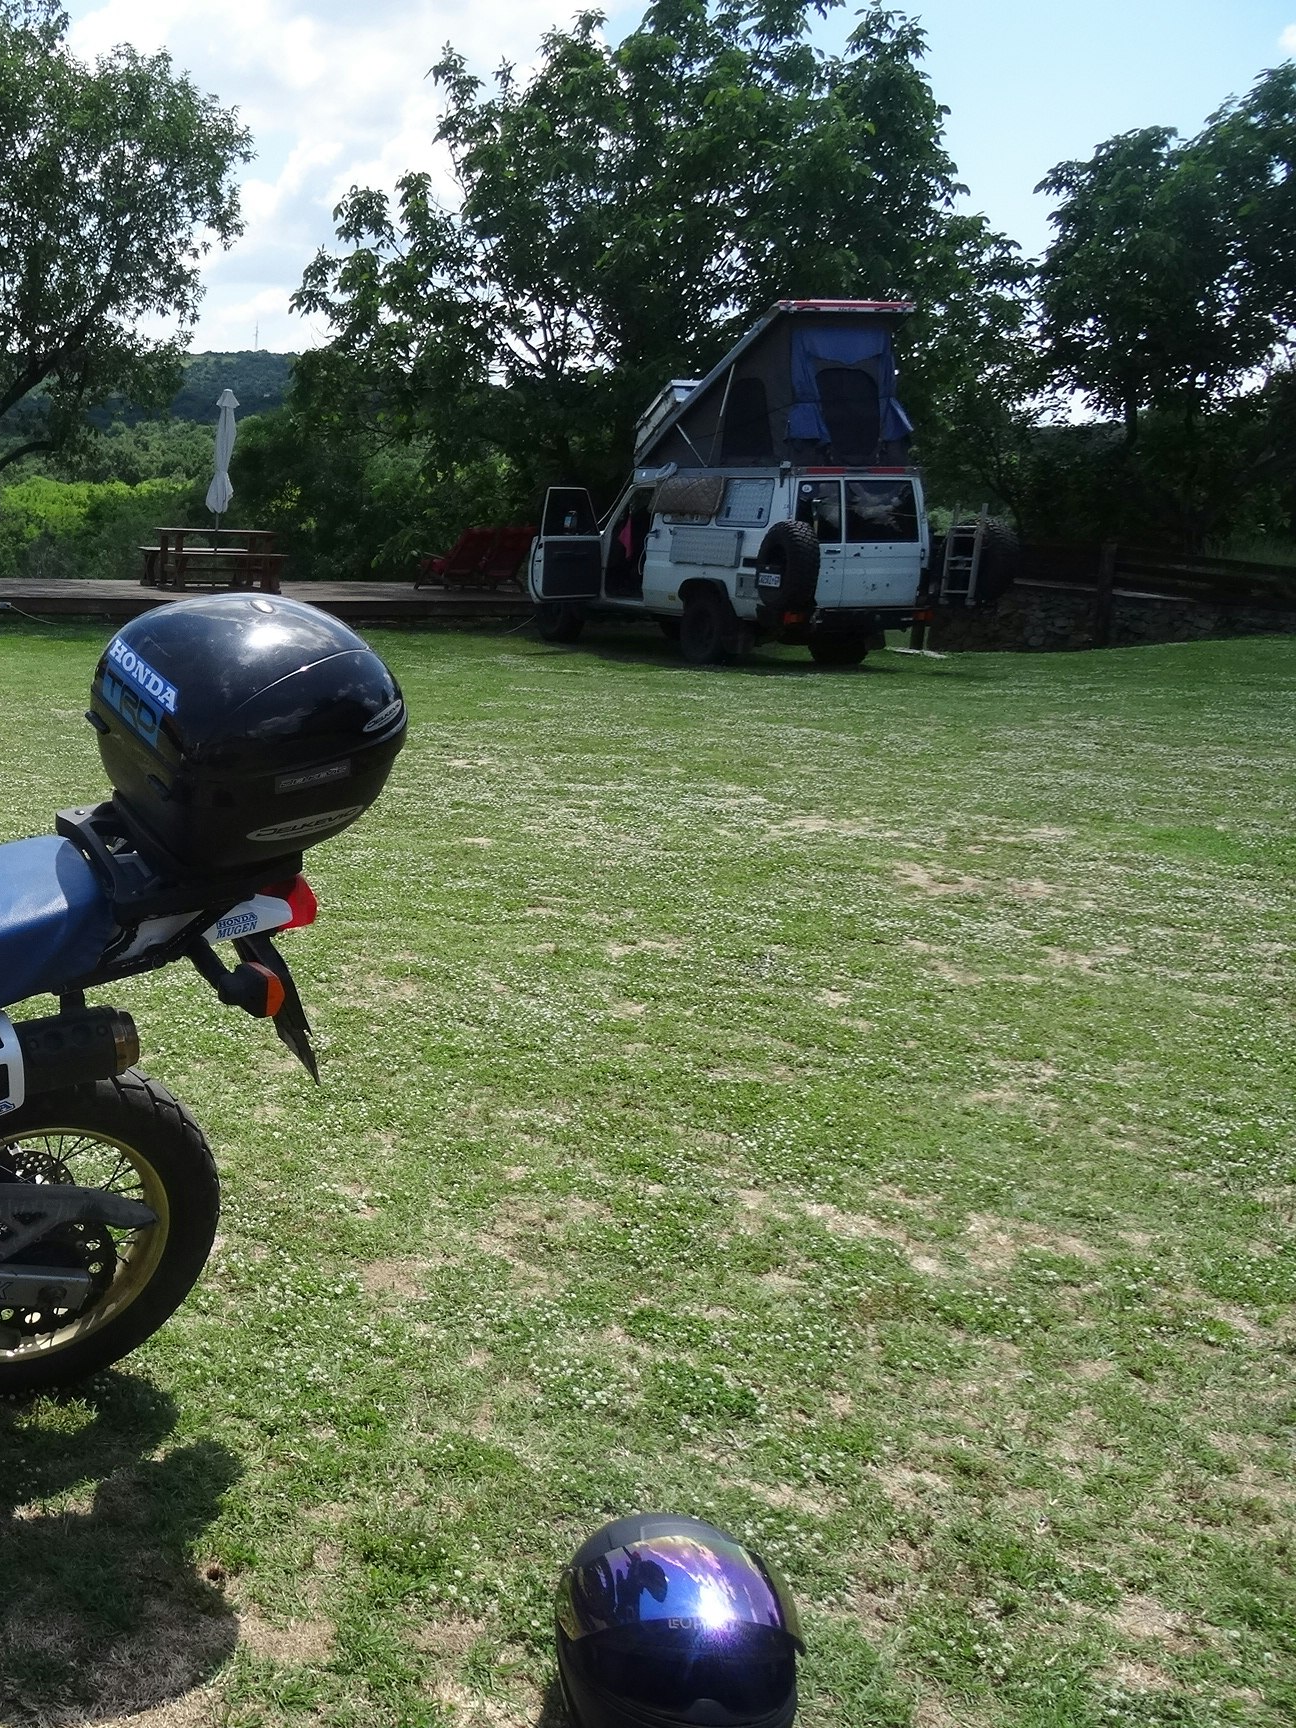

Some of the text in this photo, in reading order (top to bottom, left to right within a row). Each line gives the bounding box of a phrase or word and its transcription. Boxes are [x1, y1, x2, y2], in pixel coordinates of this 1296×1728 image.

[108, 639, 177, 713] HONDA
[218, 912, 258, 929] HONDA
[215, 921, 258, 940] MUGEN
